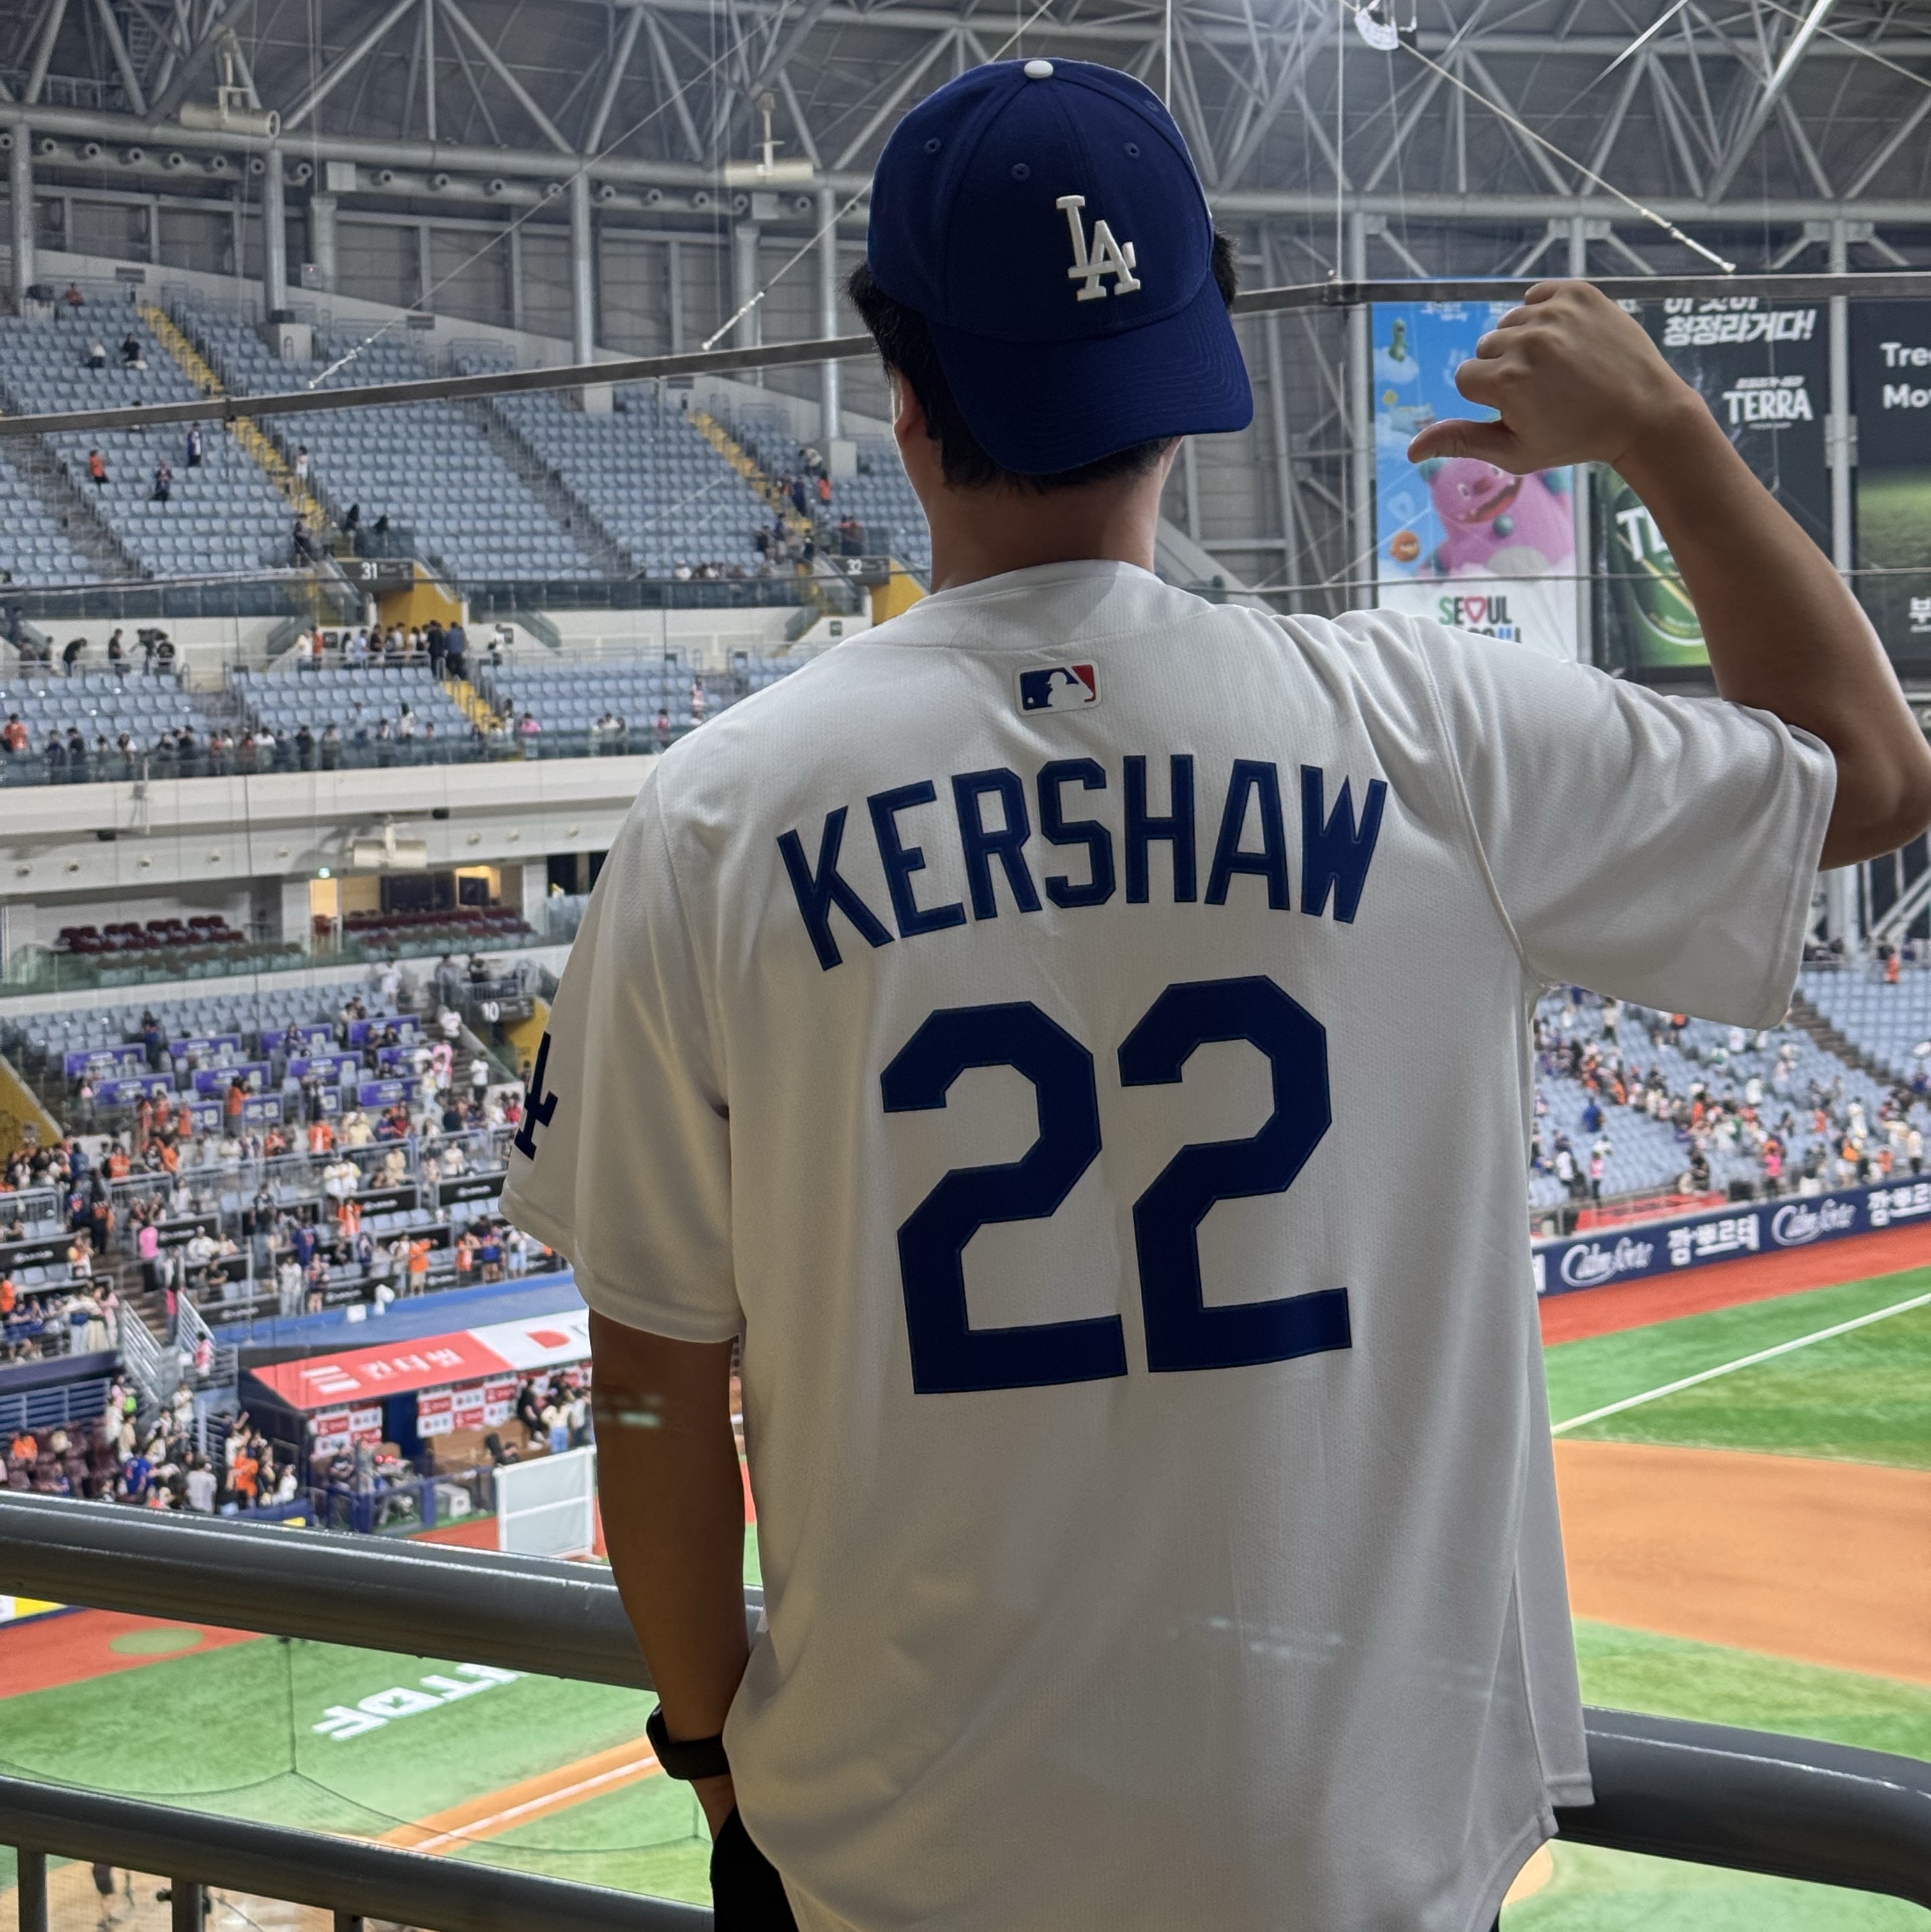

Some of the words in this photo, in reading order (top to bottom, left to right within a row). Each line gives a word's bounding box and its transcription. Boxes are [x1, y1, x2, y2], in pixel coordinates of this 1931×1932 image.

[1056, 195, 1140, 301] LA
[1880, 342, 1931, 367] Tre
[1722, 388, 1813, 425] TERRA
[362, 561, 378, 581] 31
[777, 754, 1387, 971] KERSHAW
[481, 1001, 500, 1022] 10
[880, 975, 1352, 1395] 22
